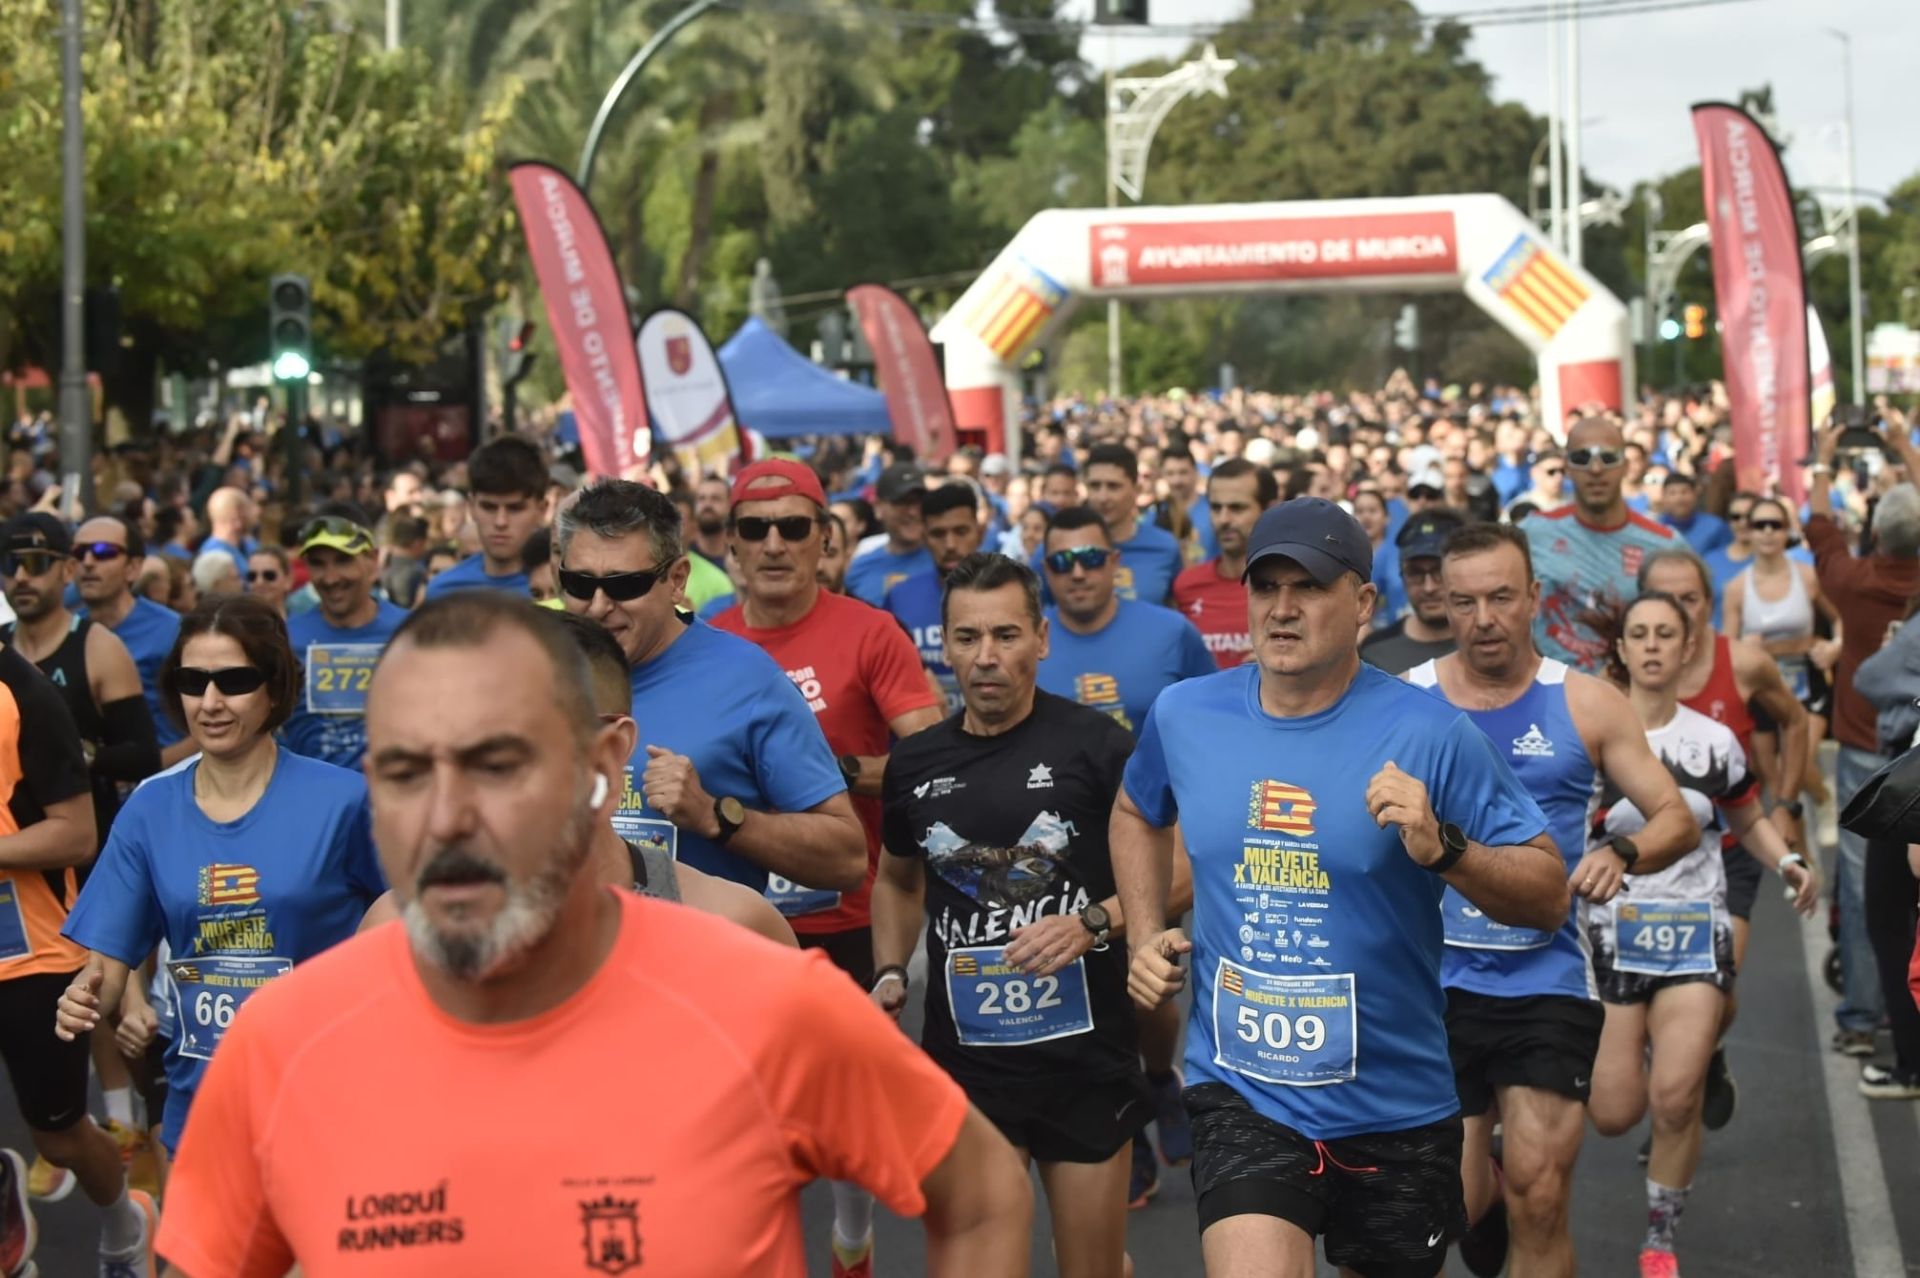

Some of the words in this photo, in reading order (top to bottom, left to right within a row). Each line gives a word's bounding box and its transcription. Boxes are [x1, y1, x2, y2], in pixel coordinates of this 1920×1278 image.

[1138, 240, 1317, 269] AYUNTAMIENTO
[1320, 238, 1352, 263] DE
[1356, 235, 1448, 260] MURCIA
[1244, 846, 1319, 871] MUÉVETE
[1233, 864, 1245, 883] X
[1249, 865, 1331, 889] VALENCIA
[200, 917, 267, 938] MUÉVETE
[1633, 925, 1697, 951] 497
[207, 933, 274, 949] VALENCIA
[975, 976, 1062, 1015] 282
[1245, 988, 1287, 1007] MUÉVETE
[1288, 996, 1296, 1008] X
[1298, 996, 1348, 1008] VALENCIA
[998, 1014, 1045, 1026] VALENCIA
[1237, 1005, 1326, 1051] 509
[1257, 1050, 1300, 1063] RICARDO
[338, 1217, 464, 1252] RUNNERS
